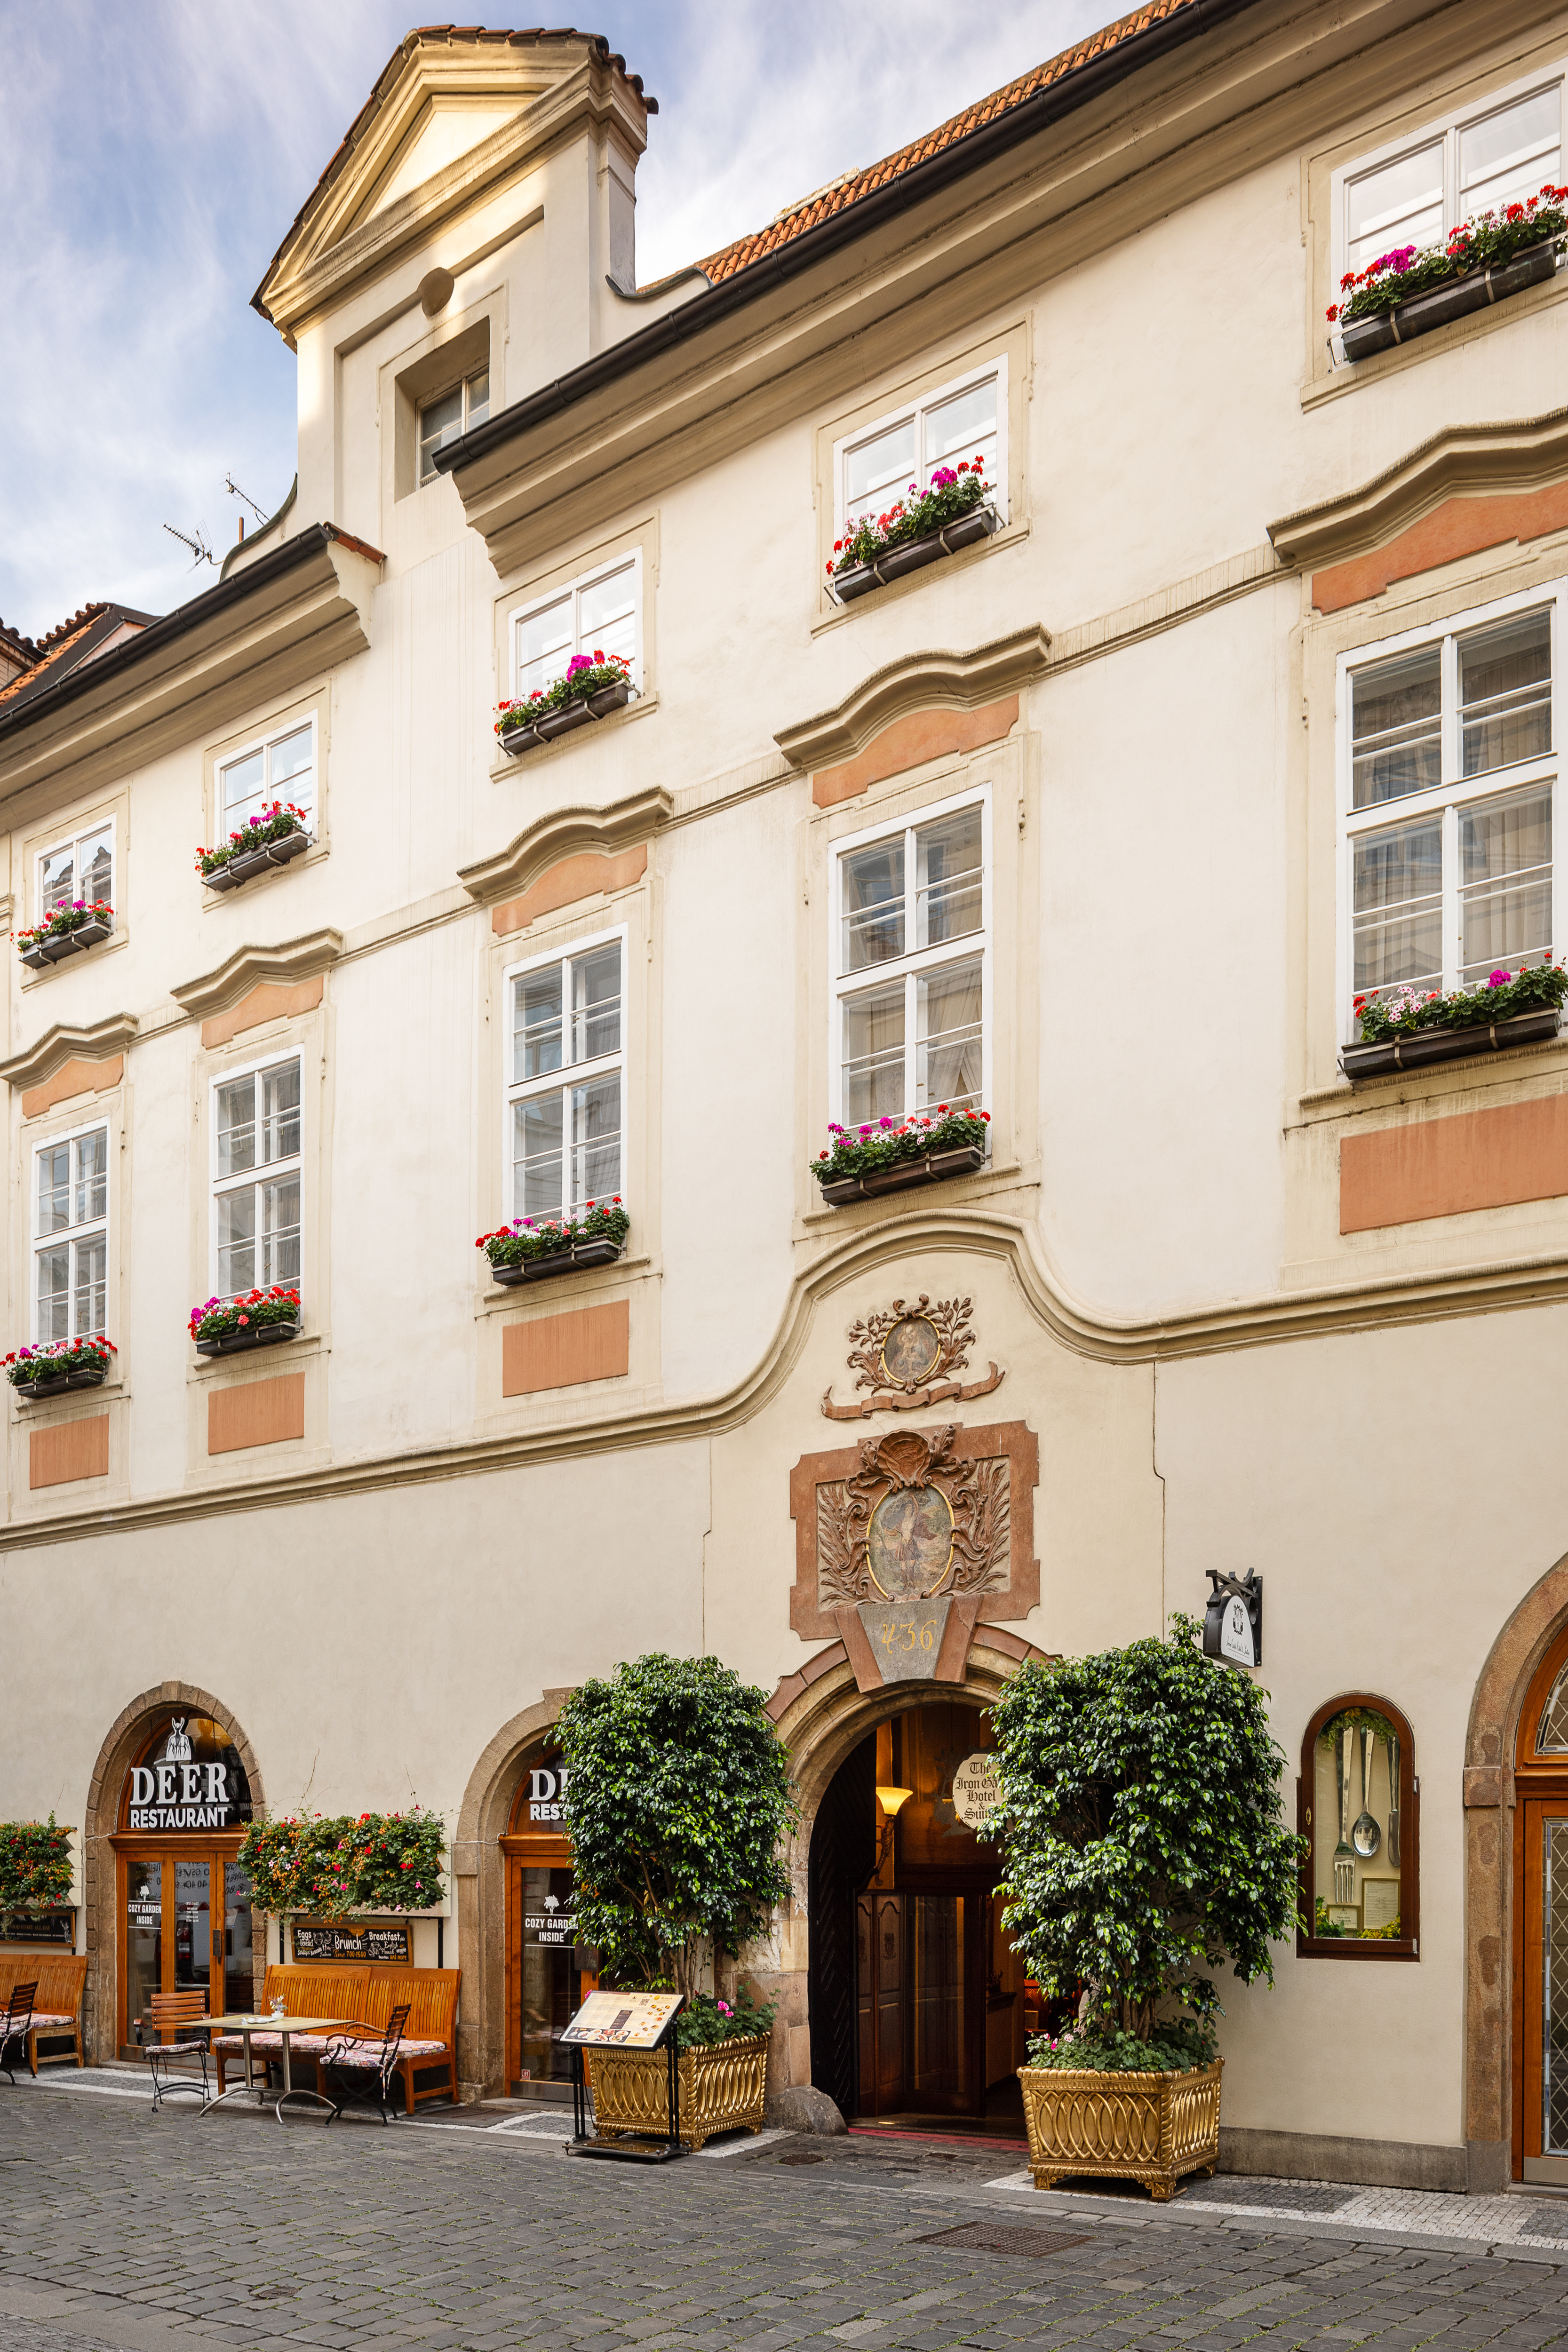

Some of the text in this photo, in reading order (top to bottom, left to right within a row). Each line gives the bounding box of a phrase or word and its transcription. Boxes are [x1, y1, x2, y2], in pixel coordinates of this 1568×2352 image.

[882, 1620, 937, 1654] 436
[969, 1761, 991, 1776] The
[130, 1763, 230, 1805] DEER
[955, 1777, 1001, 1790] Iron Ga
[966, 1789, 996, 1804] Hotel
[978, 1802, 985, 1810] &
[131, 1807, 228, 1828] RESTAURANT
[128, 1904, 161, 1914] COZY GARDEN
[137, 1915, 153, 1924] INSIDE
[525, 1918, 545, 1929] COZY
[297, 1930, 312, 1941] Eggs
[334, 1933, 362, 1950] Brunch
[369, 1931, 400, 1941] Breakfast
[539, 1931, 564, 1943] INSIDE
[333, 1949, 345, 1957] Time
